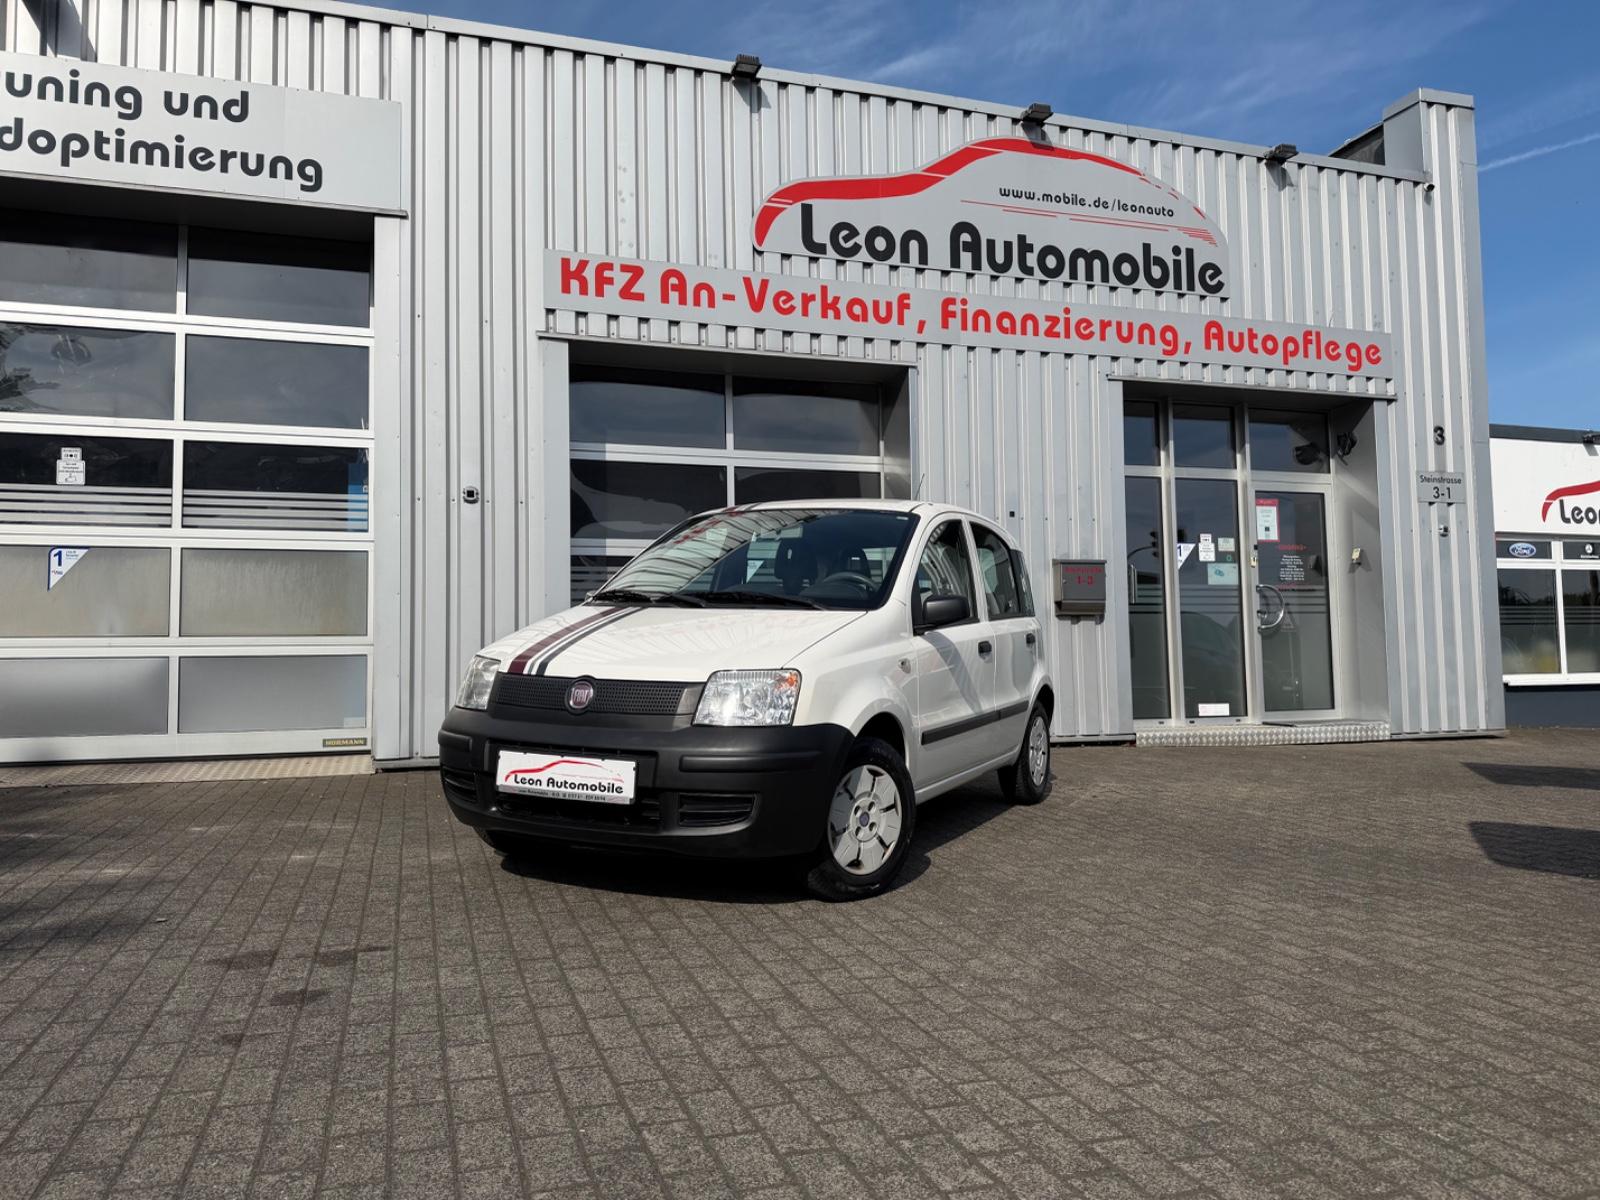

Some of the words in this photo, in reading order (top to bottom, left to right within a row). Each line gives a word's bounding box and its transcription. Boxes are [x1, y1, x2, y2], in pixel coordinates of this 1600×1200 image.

[0, 69, 142, 120] uning
[164, 90, 250, 123] und
[0, 117, 323, 193] doptimierung
[999, 187, 1174, 218] www.mobile.de/leonauto
[801, 202, 929, 266] Leon
[949, 221, 1226, 296] Automobile
[940, 297, 1192, 357] Finanzierung,
[1203, 319, 1384, 372] Autopflege
[1433, 425, 1446, 446] 3
[1419, 474, 1462, 485] Steinstrasse
[1432, 486, 1451, 499] 3-1
[1559, 499, 1600, 525] Leo
[53, 550, 63, 567] 1
[514, 774, 542, 787] Leon
[546, 777, 624, 794] Automobile
